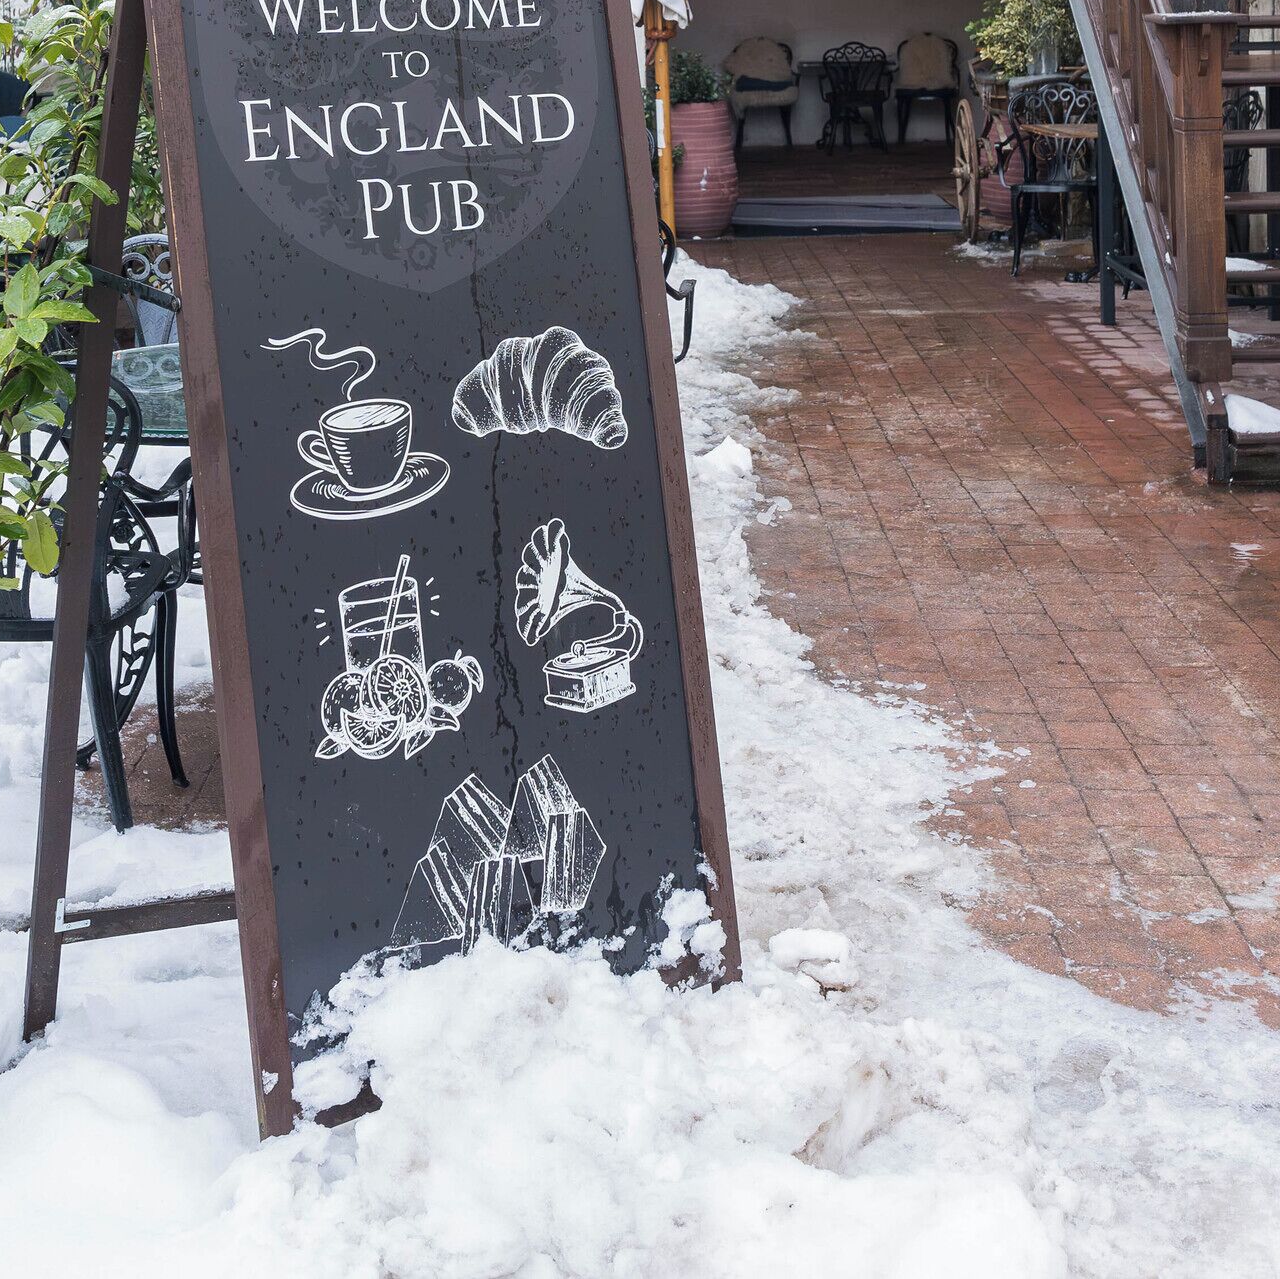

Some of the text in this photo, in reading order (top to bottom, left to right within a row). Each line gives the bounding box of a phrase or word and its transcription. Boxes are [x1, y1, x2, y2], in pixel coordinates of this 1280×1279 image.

[381, 50, 431, 79] TO
[238, 93, 576, 163] ENGLAND
[356, 177, 486, 240] PUB
